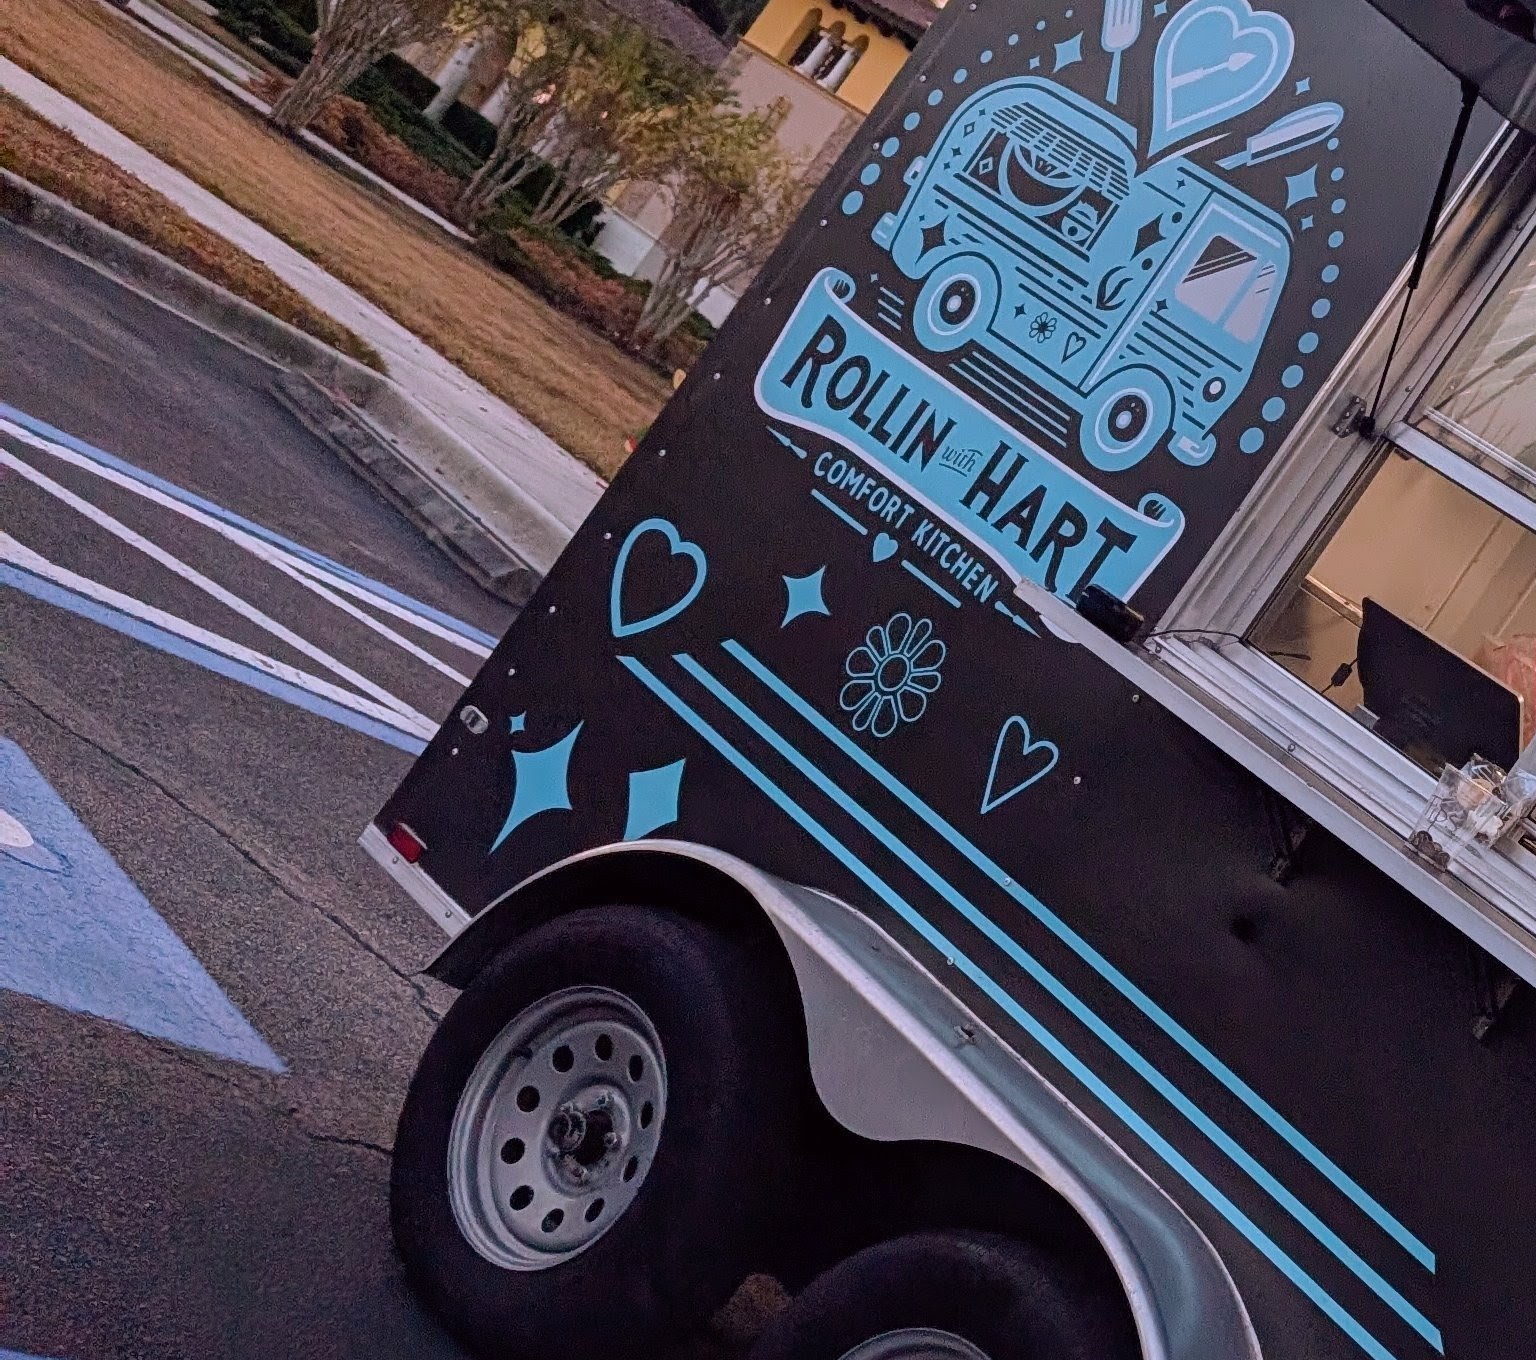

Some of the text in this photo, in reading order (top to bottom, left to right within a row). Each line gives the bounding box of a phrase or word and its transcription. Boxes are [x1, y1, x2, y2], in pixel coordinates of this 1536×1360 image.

[781, 315, 1136, 604] ROLLIN with HART
[812, 449, 999, 604] COMFORT KITCHEN
